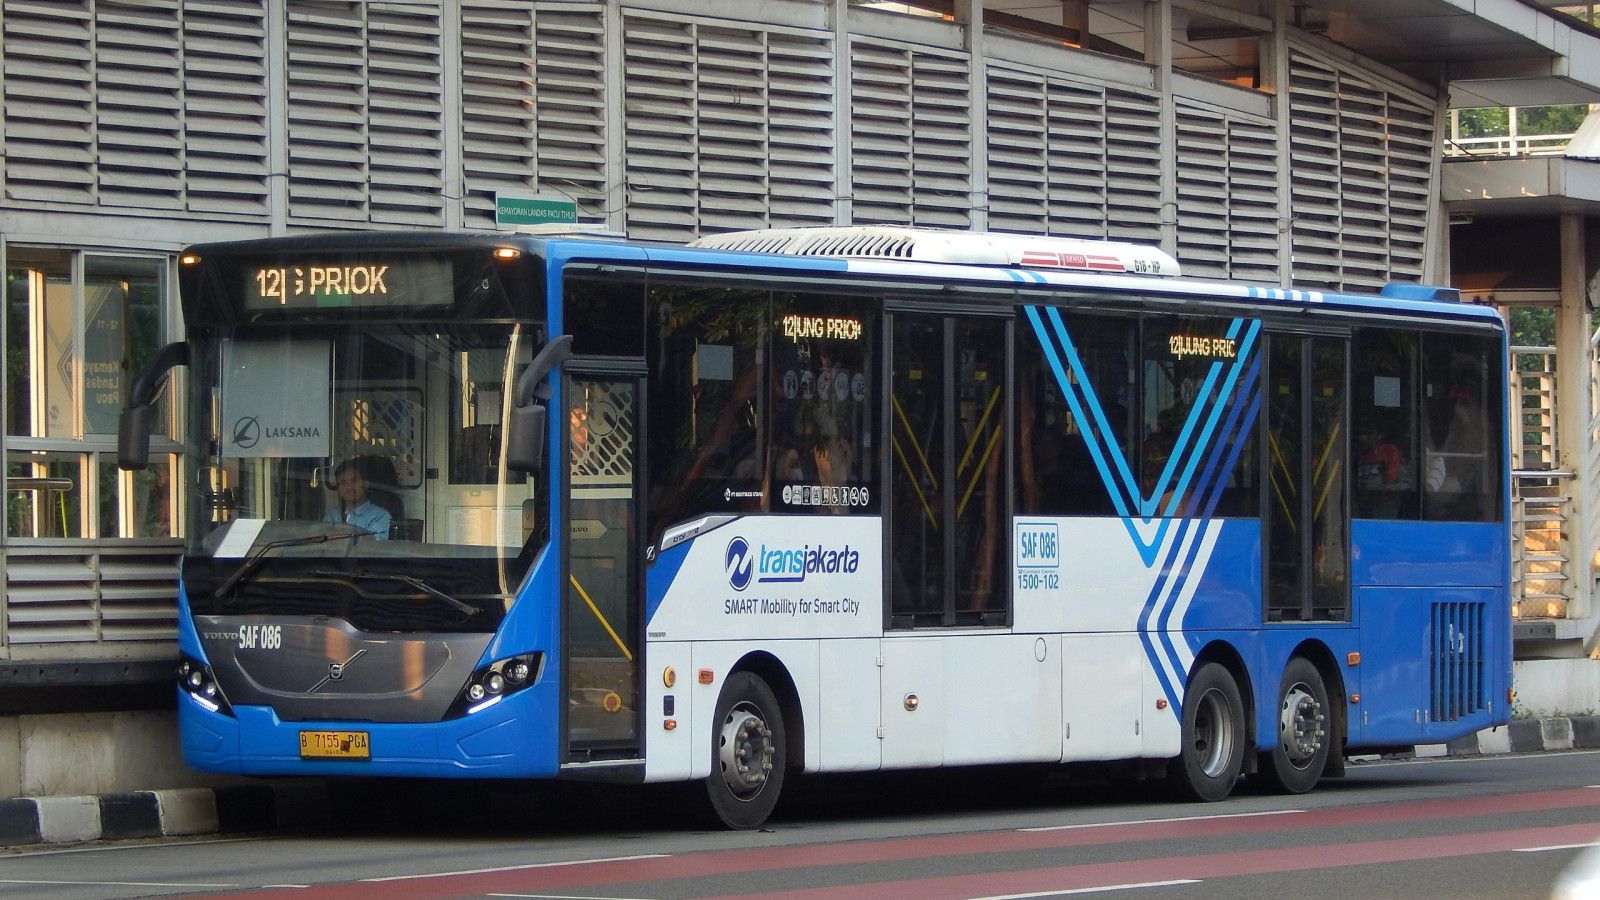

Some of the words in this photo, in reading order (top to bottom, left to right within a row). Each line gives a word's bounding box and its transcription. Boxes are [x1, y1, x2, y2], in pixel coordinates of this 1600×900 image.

[498, 206, 528, 217] KEMAYORAN
[528, 208, 547, 218] LANDAS
[547, 209, 560, 218] PACU
[561, 211, 576, 220] TIMUR
[1066, 254, 1084, 264] DENSO
[310, 266, 389, 296] PRIOK
[265, 427, 320, 438] LAKSANA
[1021, 531, 1037, 559] SAF
[1040, 531, 1056, 559] 086
[758, 544, 860, 583] transjakarta
[1018, 574, 1059, 590] 1500-102
[724, 599, 759, 615] SMART
[760, 598, 798, 617] Mobility
[799, 598, 812, 614] for
[813, 598, 840, 614] Smart
[842, 598, 860, 617] City
[203, 632, 239, 640] VOLVO
[239, 624, 258, 649] SAF
[260, 625, 281, 649] 086
[301, 734, 308, 748] B
[315, 734, 339, 748] 7155
[348, 734, 367, 748] PGA
